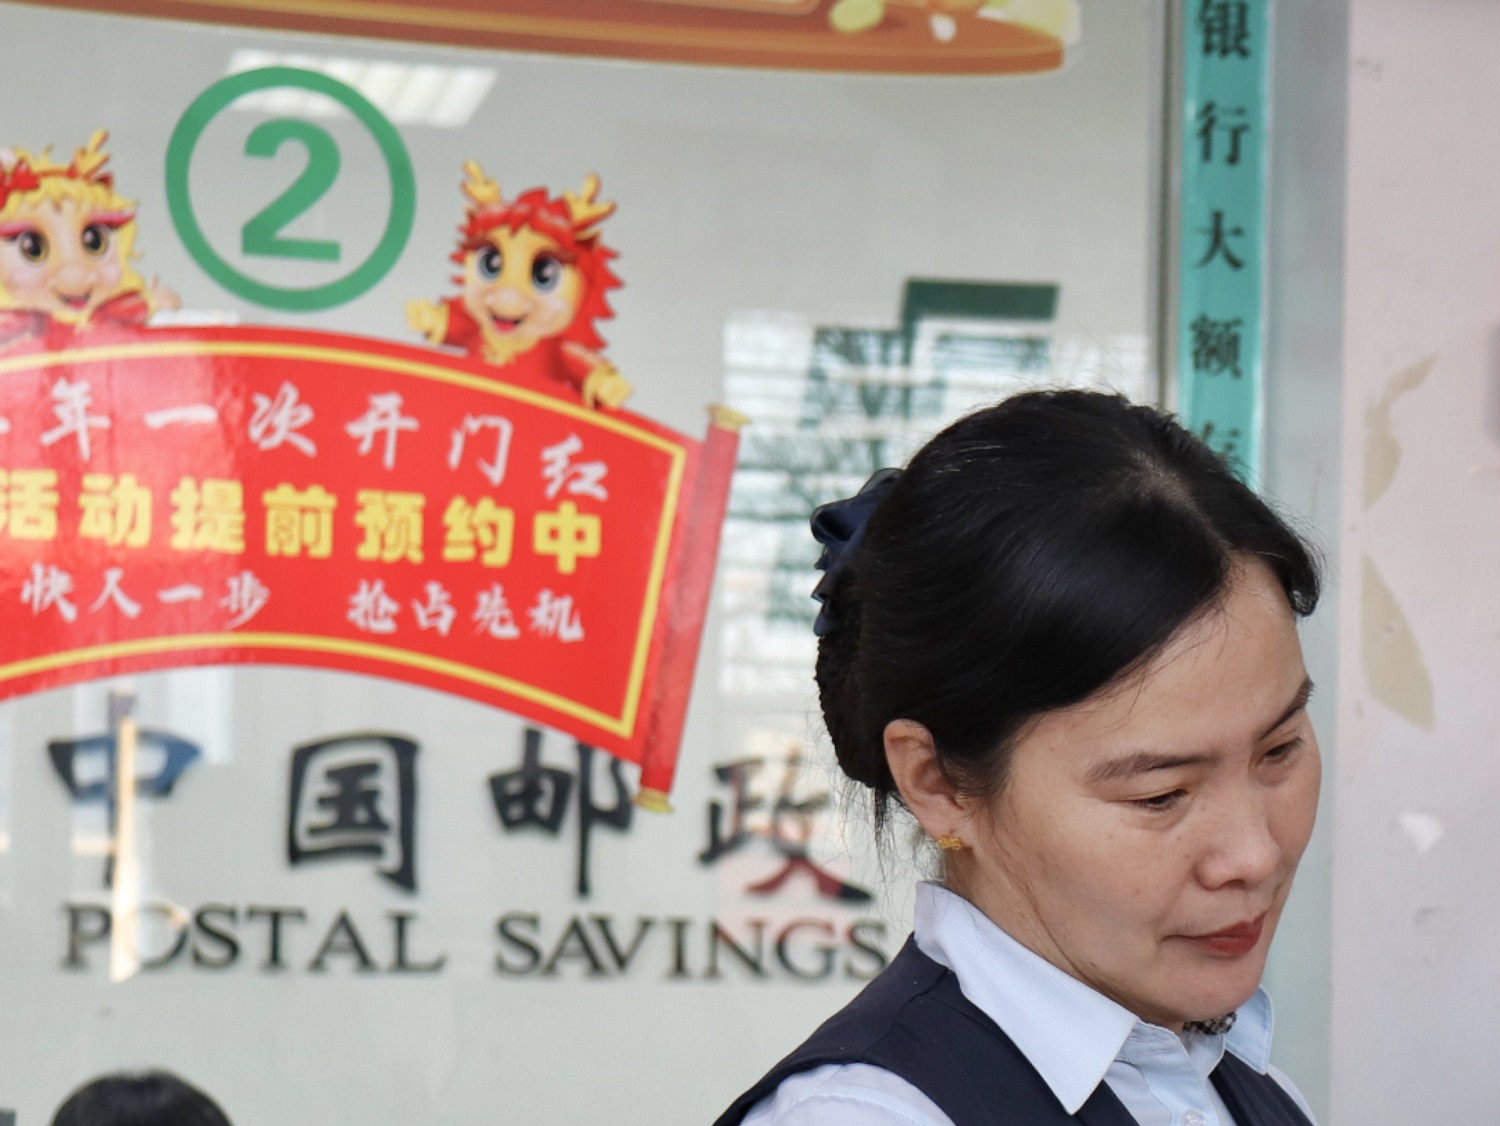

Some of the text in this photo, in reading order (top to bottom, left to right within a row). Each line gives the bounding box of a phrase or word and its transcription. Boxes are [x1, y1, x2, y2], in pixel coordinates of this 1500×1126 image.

[241, 118, 342, 263] 2
[0, 377, 608, 500] 年一次开门红
[0, 468, 601, 574] 活动提前预约中
[20, 561, 586, 643] 快人一步 抢占先机
[46, 690, 874, 905] 中国邮政
[62, 902, 890, 980] POSTAL SAVINGS
